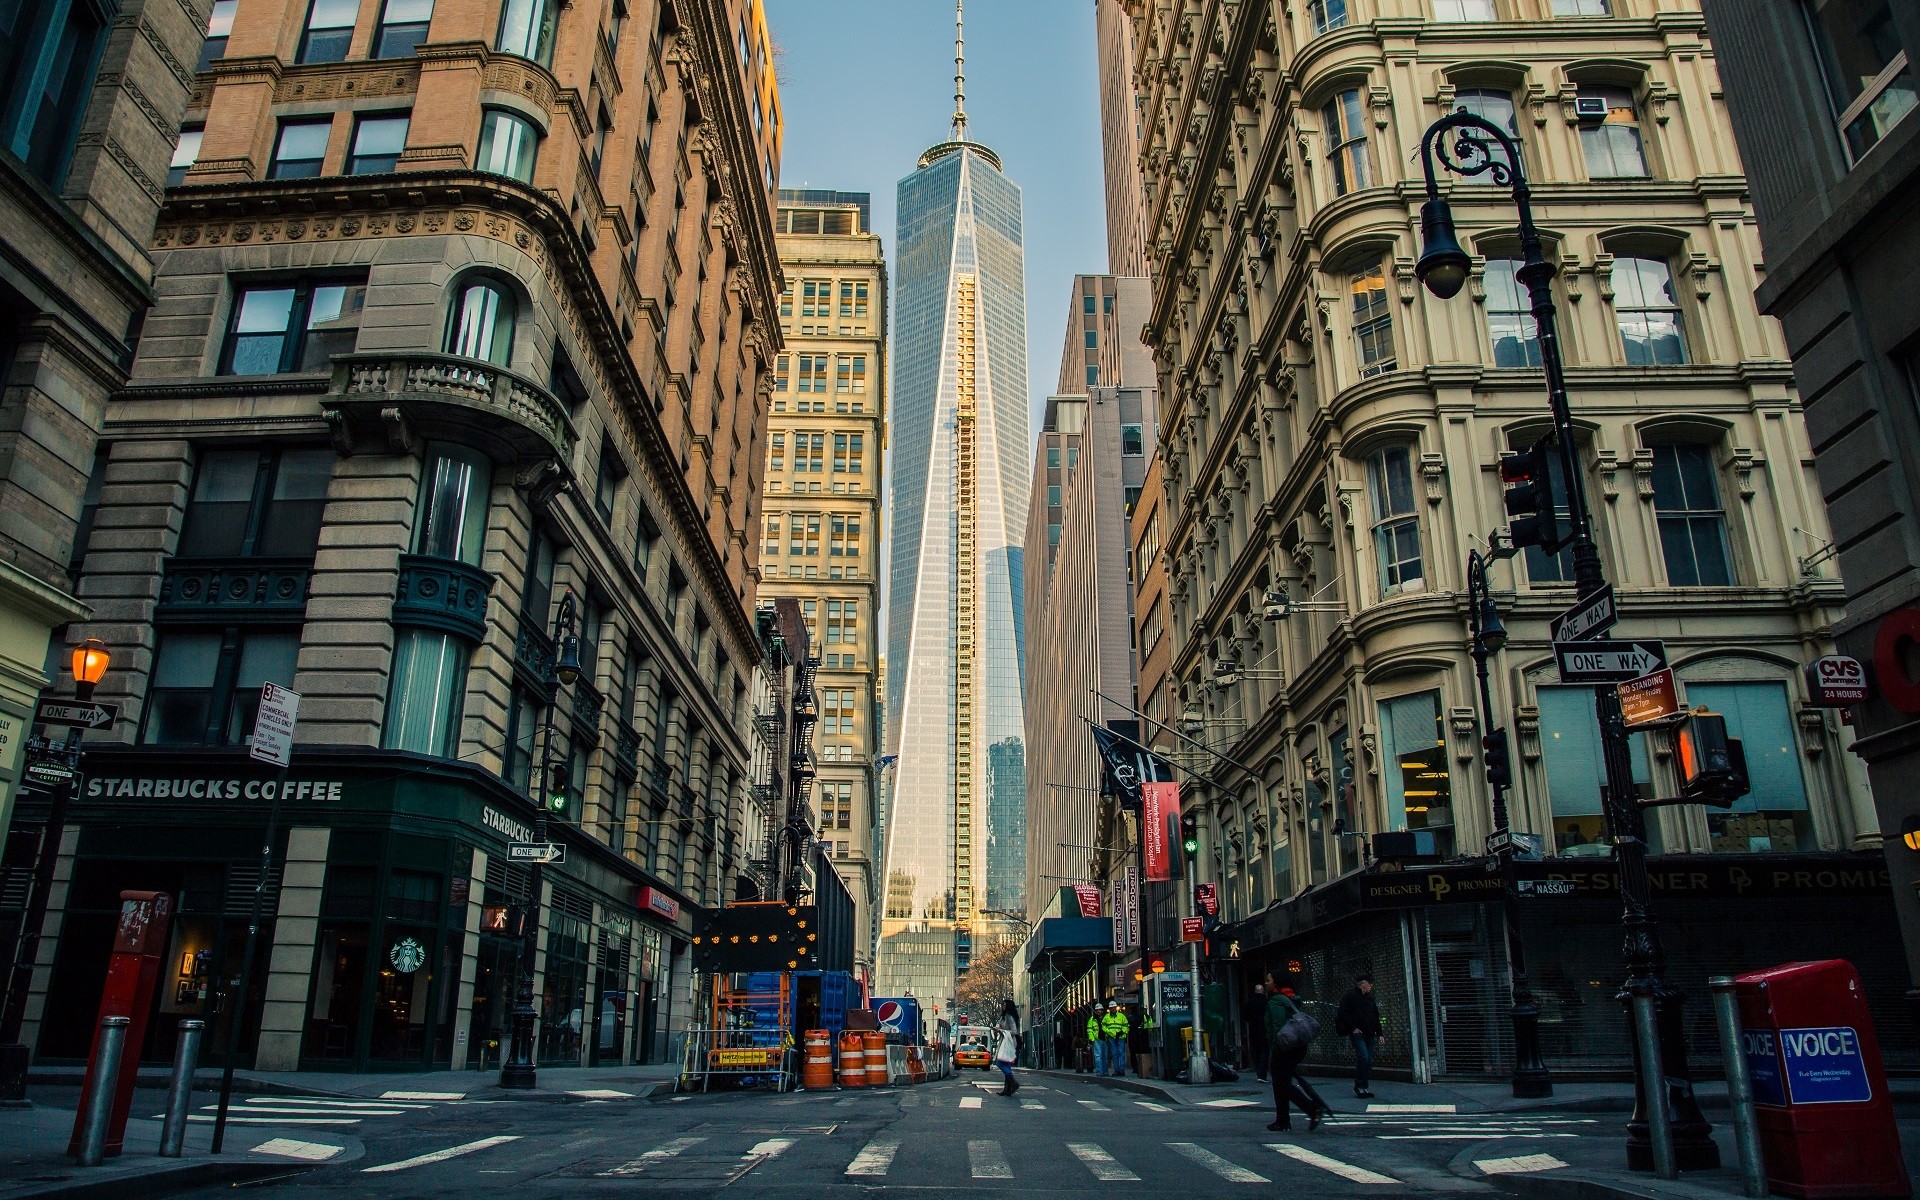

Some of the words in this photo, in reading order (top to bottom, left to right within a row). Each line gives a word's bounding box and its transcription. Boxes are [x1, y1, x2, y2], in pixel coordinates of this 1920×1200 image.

[1561, 619, 1579, 641] ONE
[1585, 601, 1605, 627] WAY
[1573, 654, 1606, 670] ONE
[1617, 653, 1649, 669] WAY
[1819, 660, 1860, 677] CVS
[1620, 684, 1630, 694] NO
[1632, 675, 1664, 692] STANDING
[1822, 677, 1861, 685] pharmacy
[264, 685, 272, 700] 3
[1622, 693, 1641, 703] Monday
[1645, 687, 1661, 697] Friday
[1824, 690, 1835, 698] 24
[1836, 690, 1863, 698] HOURS
[46, 706, 70, 718] ONE
[79, 709, 104, 722] WAY
[262, 704, 290, 719] COMMERCIAL
[260, 712, 281, 725] VEHICLES
[281, 719, 293, 728] ONLY
[87, 777, 240, 799] STARBUCKS
[244, 781, 343, 801] COFFEE
[482, 805, 531, 844] STARBUCKS
[516, 848, 533, 856] ONE
[1548, 871, 1709, 890] ESINER
[1772, 869, 1892, 889] PROMIS
[1128, 867, 1136, 909] Roberts
[1370, 884, 1422, 897] DESIGNER
[1536, 884, 1569, 894] NASSAU
[1744, 1033, 1775, 1056] OICE
[1788, 1031, 1856, 1057] VOICE
[1810, 1070, 1823, 1078] Every
